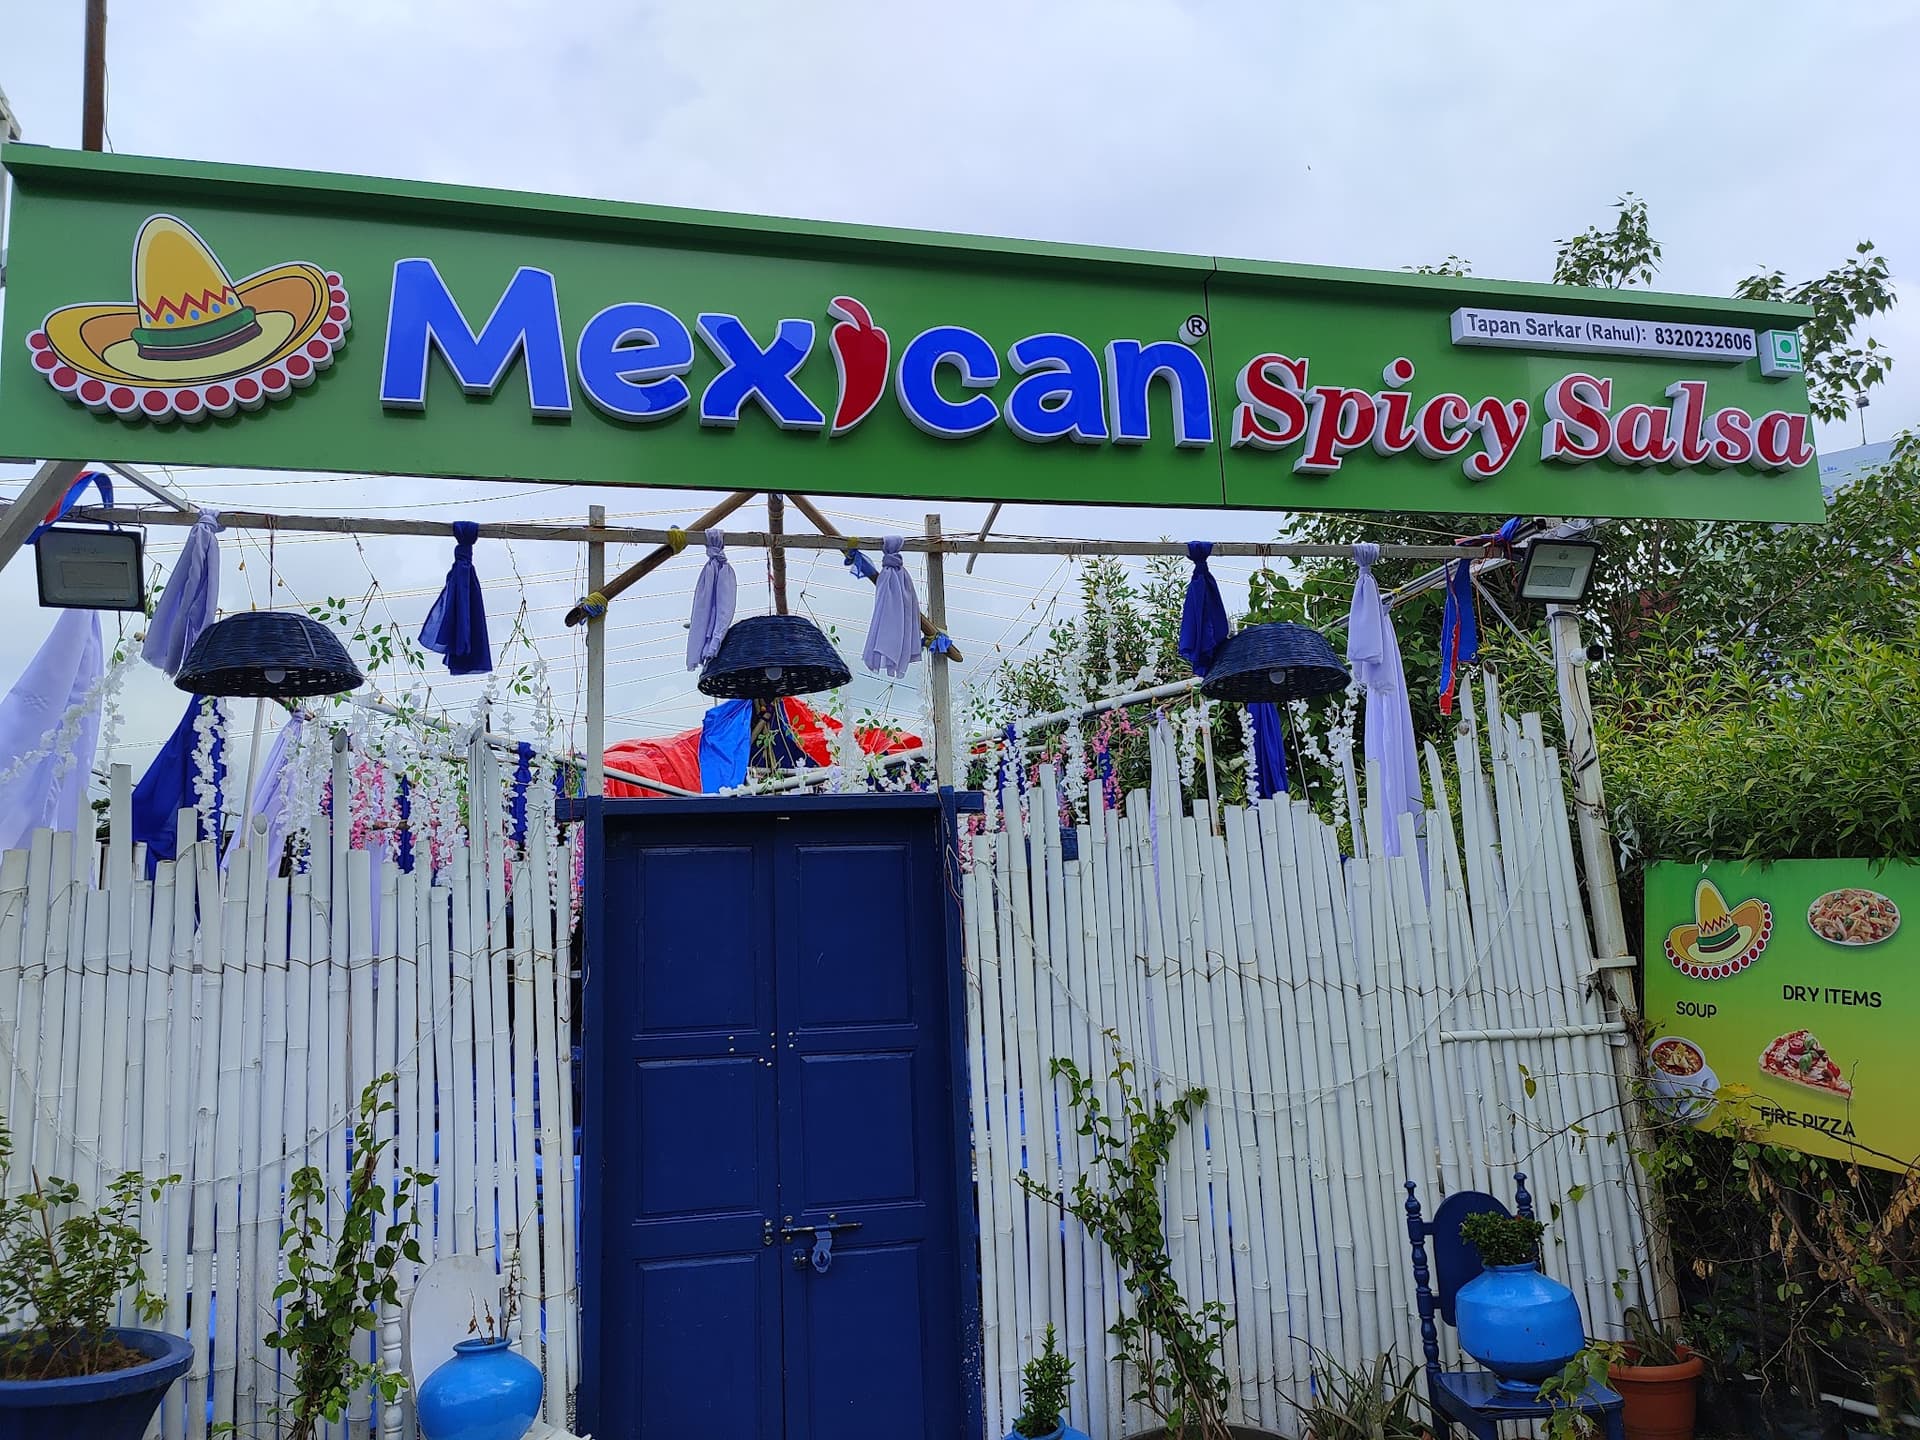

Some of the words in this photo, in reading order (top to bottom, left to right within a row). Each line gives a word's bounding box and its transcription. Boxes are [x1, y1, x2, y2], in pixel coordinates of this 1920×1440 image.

[1467, 313, 1520, 337] Tapan
[1525, 318, 1582, 339] Sarkar
[1586, 322, 1647, 344] (Rahul):
[1655, 327, 1752, 351] 8320232606
[379, 256, 1214, 448] Mexican
[1231, 353, 1529, 480] Spicy
[1540, 373, 1815, 471] Salsa
[1676, 1001, 1717, 1018] SOUP
[1783, 985, 1820, 1002] DRY
[1824, 988, 1882, 1008] ITEMS
[1761, 1106, 1798, 1126] FIRE
[1803, 1113, 1856, 1137] PIZZA
